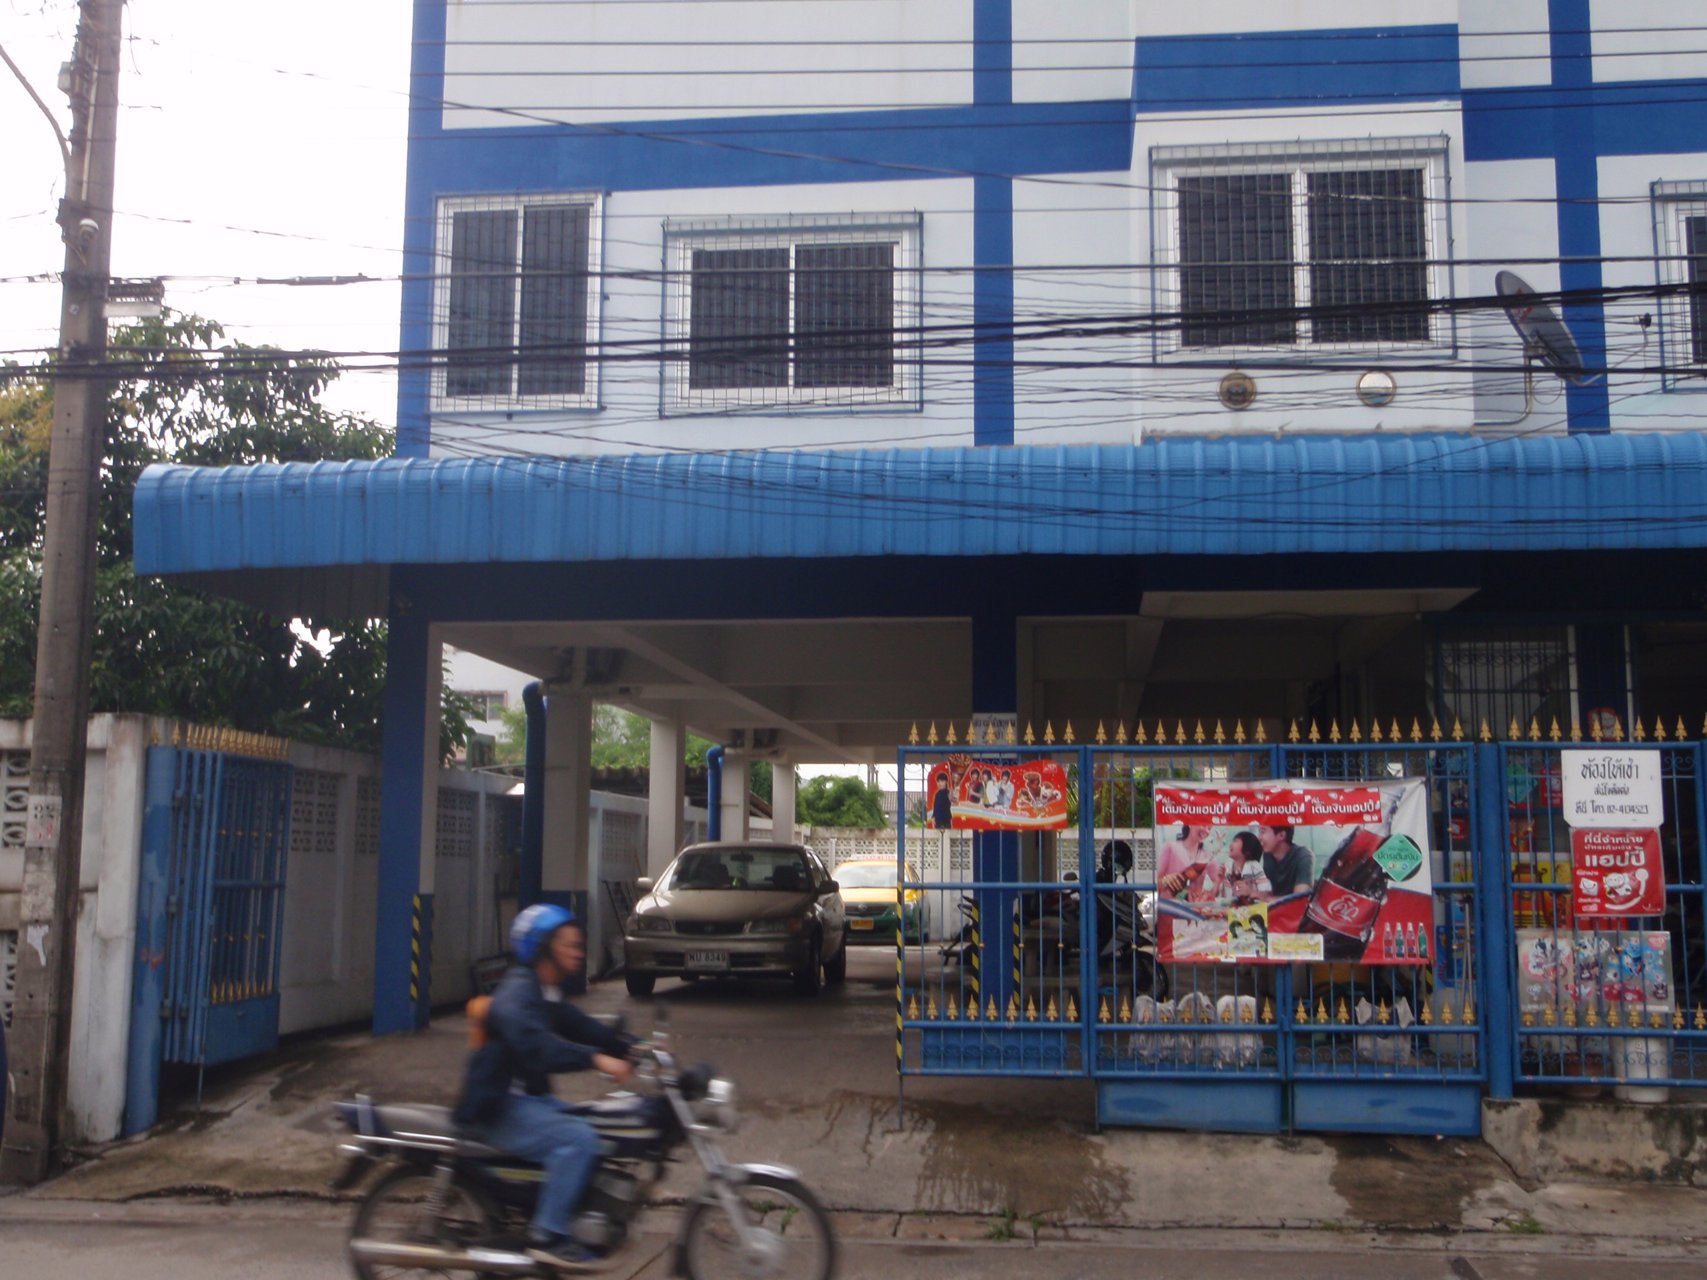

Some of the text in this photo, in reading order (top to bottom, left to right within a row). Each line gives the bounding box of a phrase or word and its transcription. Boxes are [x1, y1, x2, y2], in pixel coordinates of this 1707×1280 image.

[1581, 756, 1639, 779] ห้องให้เช่า
[1162, 801, 1224, 814] เติมเงินแฮปปี้
[1237, 801, 1299, 815] เติมเงินแฮปปี้
[1312, 799, 1375, 814] เติมเงินแฮปปี้
[1584, 832, 1643, 844] ที่นี่จำหน่าย
[1585, 846, 1645, 867] แฮปปี้
